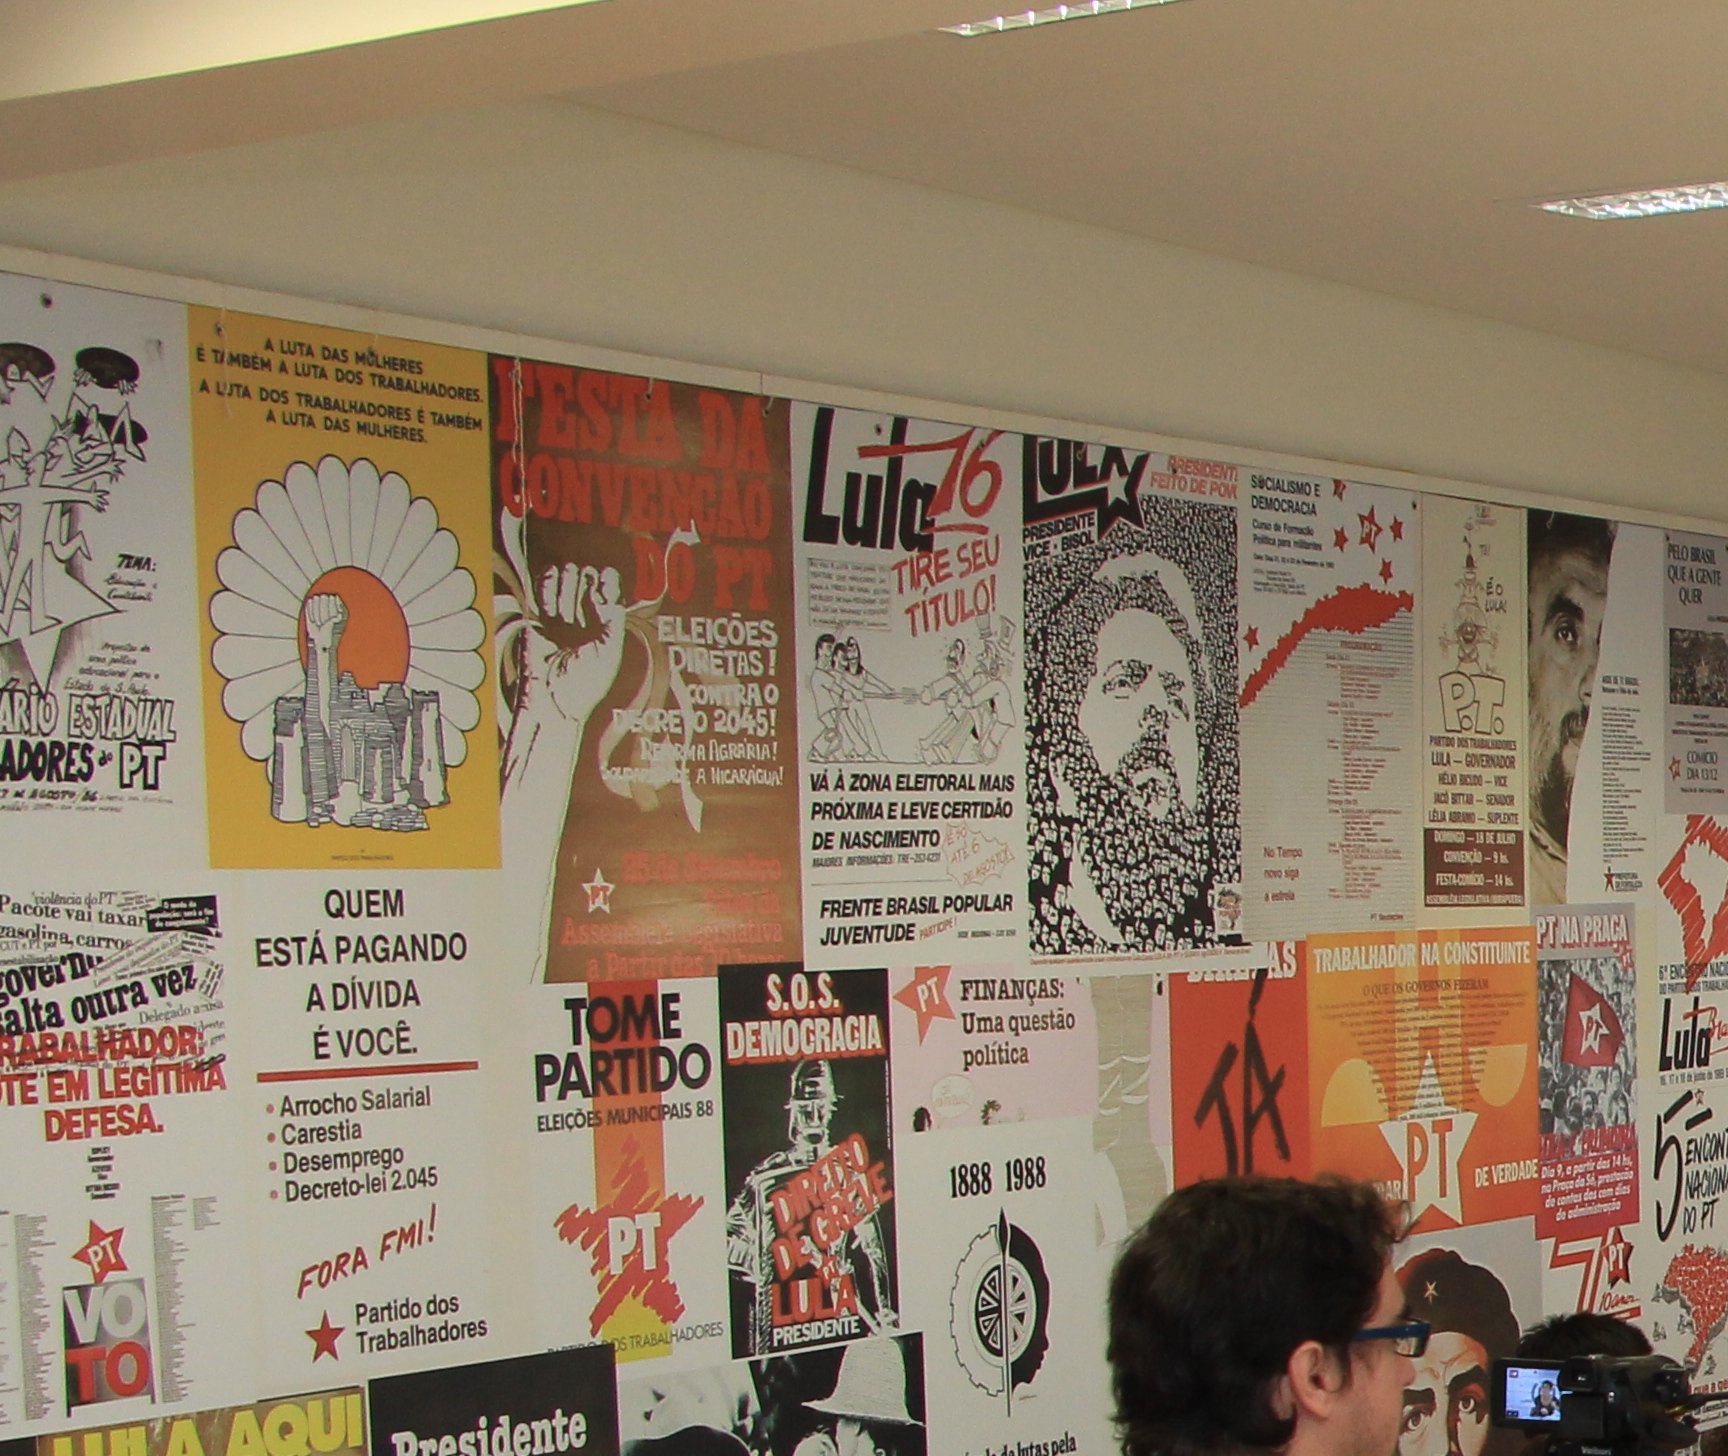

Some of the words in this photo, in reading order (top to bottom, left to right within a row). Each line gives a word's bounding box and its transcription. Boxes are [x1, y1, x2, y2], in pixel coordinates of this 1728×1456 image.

[264, 338, 274, 352] A
[279, 340, 314, 358] LUTA
[322, 346, 349, 363] DAS
[355, 351, 423, 375] MULHERES
[493, 357, 684, 460] FESTA
[698, 391, 770, 474] DA
[803, 406, 938, 552] Lula
[1251, 474, 1312, 497] SOCIALISMO
[1314, 482, 1321, 498] E
[1251, 494, 1318, 517] DEMOCRACIA
[1023, 511, 1097, 543] PRESIDENTE
[1023, 543, 1051, 561] VICE
[1061, 529, 1096, 552] BISOL
[117, 553, 158, 573] TEMA:
[632, 537, 696, 604] DO
[714, 545, 773, 611] PT
[892, 549, 953, 595] TIRE
[956, 534, 999, 579] SEU
[904, 574, 998, 638] TÍTULO!
[657, 612, 779, 650] ELEIÇÕES
[668, 645, 778, 678] DIRETAS!
[67, 692, 177, 744] ESTADUAL
[1439, 671, 1506, 735] P.T.
[119, 741, 167, 791] PT
[810, 768, 829, 791] VÁ
[834, 768, 845, 791] À
[850, 773, 891, 791] ZONA
[895, 773, 976, 791] ELEITORAL
[979, 774, 1015, 792] MAIS
[324, 888, 405, 919] QUEM
[820, 898, 883, 919] FRENTE
[886, 896, 940, 917] BRASIL
[942, 893, 1014, 913] POPULAR
[255, 929, 328, 968] ESTÁ
[335, 932, 468, 964] PAGANDO
[820, 922, 917, 947] JUVENTUDE
[1313, 943, 1415, 973] TRABALHADOR
[1421, 943, 1440, 966] NA
[1444, 940, 1532, 966] CONSTITUINTE
[71, 979, 149, 1024] outra
[151, 963, 198, 998] vez
[306, 983, 326, 1012] A
[332, 976, 421, 1011] DÍVIDA
[766, 973, 840, 1012] S.O.S.
[960, 977, 1065, 1006] FINANÇAS:
[564, 993, 682, 1046] TOME
[725, 1014, 884, 1061] DEMOCRACIA
[961, 1011, 1003, 1035] Uma
[1008, 1009, 1076, 1037] questão
[313, 1024, 331, 1059] É
[336, 1020, 418, 1057] VOCÊ.
[962, 1042, 1030, 1072] política
[49, 1068, 89, 1103] EM
[98, 1060, 227, 1099] LEGÍTIMA
[535, 1042, 712, 1103] PARTIDO
[280, 1093, 358, 1118] Arrocho
[362, 1085, 432, 1111] Salarial
[537, 1108, 602, 1132] ELEIÇÕES
[606, 1103, 693, 1127] MUNICIPAIS
[696, 1099, 714, 1118] 88
[44, 1103, 164, 1142] DEFESA.
[281, 1119, 362, 1146] Carestia
[283, 1148, 404, 1176] Desemprego
[950, 1162, 992, 1199] 1888
[1005, 1156, 1047, 1193] 1988
[1405, 1119, 1453, 1200] PT
[1475, 1167, 1489, 1187] DE
[1492, 1158, 1539, 1186] VERDADE
[286, 1172, 387, 1202] Decreto-lei
[391, 1166, 438, 1191] 2.045
[297, 1246, 369, 1300] FORA
[379, 1202, 437, 1262] FMI!
[607, 1212, 662, 1276] PT
[355, 1298, 421, 1326] Partido
[426, 1294, 459, 1316] dos
[772, 1278, 859, 1328] LULA
[356, 1319, 488, 1355] Trabalhadores
[773, 1316, 861, 1348] PRESIDENTE
